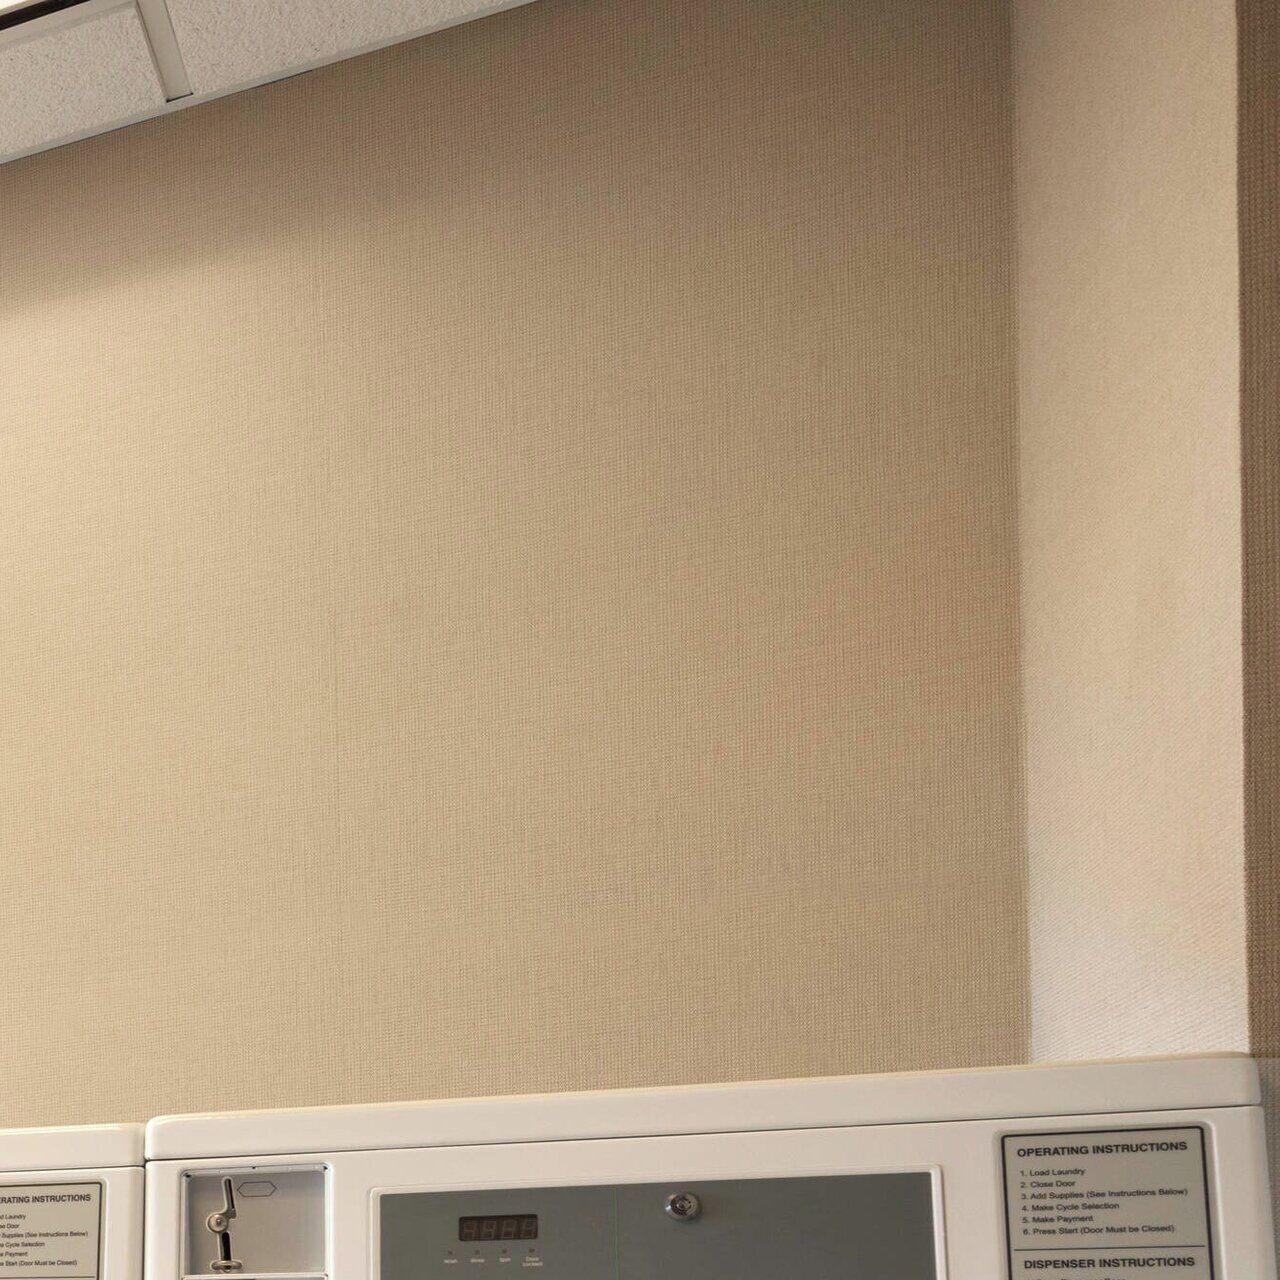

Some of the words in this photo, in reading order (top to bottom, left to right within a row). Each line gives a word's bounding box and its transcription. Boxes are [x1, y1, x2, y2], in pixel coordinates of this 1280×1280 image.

[1016, 1145, 1090, 1158] OPERATING
[1092, 1141, 1188, 1155] INSTRUCTIONS
[1051, 1168, 1086, 1177] Laundry
[31, 1194, 91, 1203] INSTRUCTIONS
[1048, 1191, 1085, 1200] Supplies
[1086, 1191, 1107, 1199] (See
[1107, 1189, 1157, 1197] Instructions
[1157, 1188, 1189, 1197] Below)
[1031, 1204, 1055, 1212] Make
[1055, 1203, 1080, 1212] Cycle
[1081, 1202, 1120, 1210] Selection
[1056, 1215, 1094, 1224] Payment
[1079, 1226, 1104, 1235] (Door
[1141, 1224, 1175, 1234] Closed)
[1023, 1259, 1096, 1270] DISPENSER
[1098, 1256, 1196, 1269] INSTRUCTIONS
